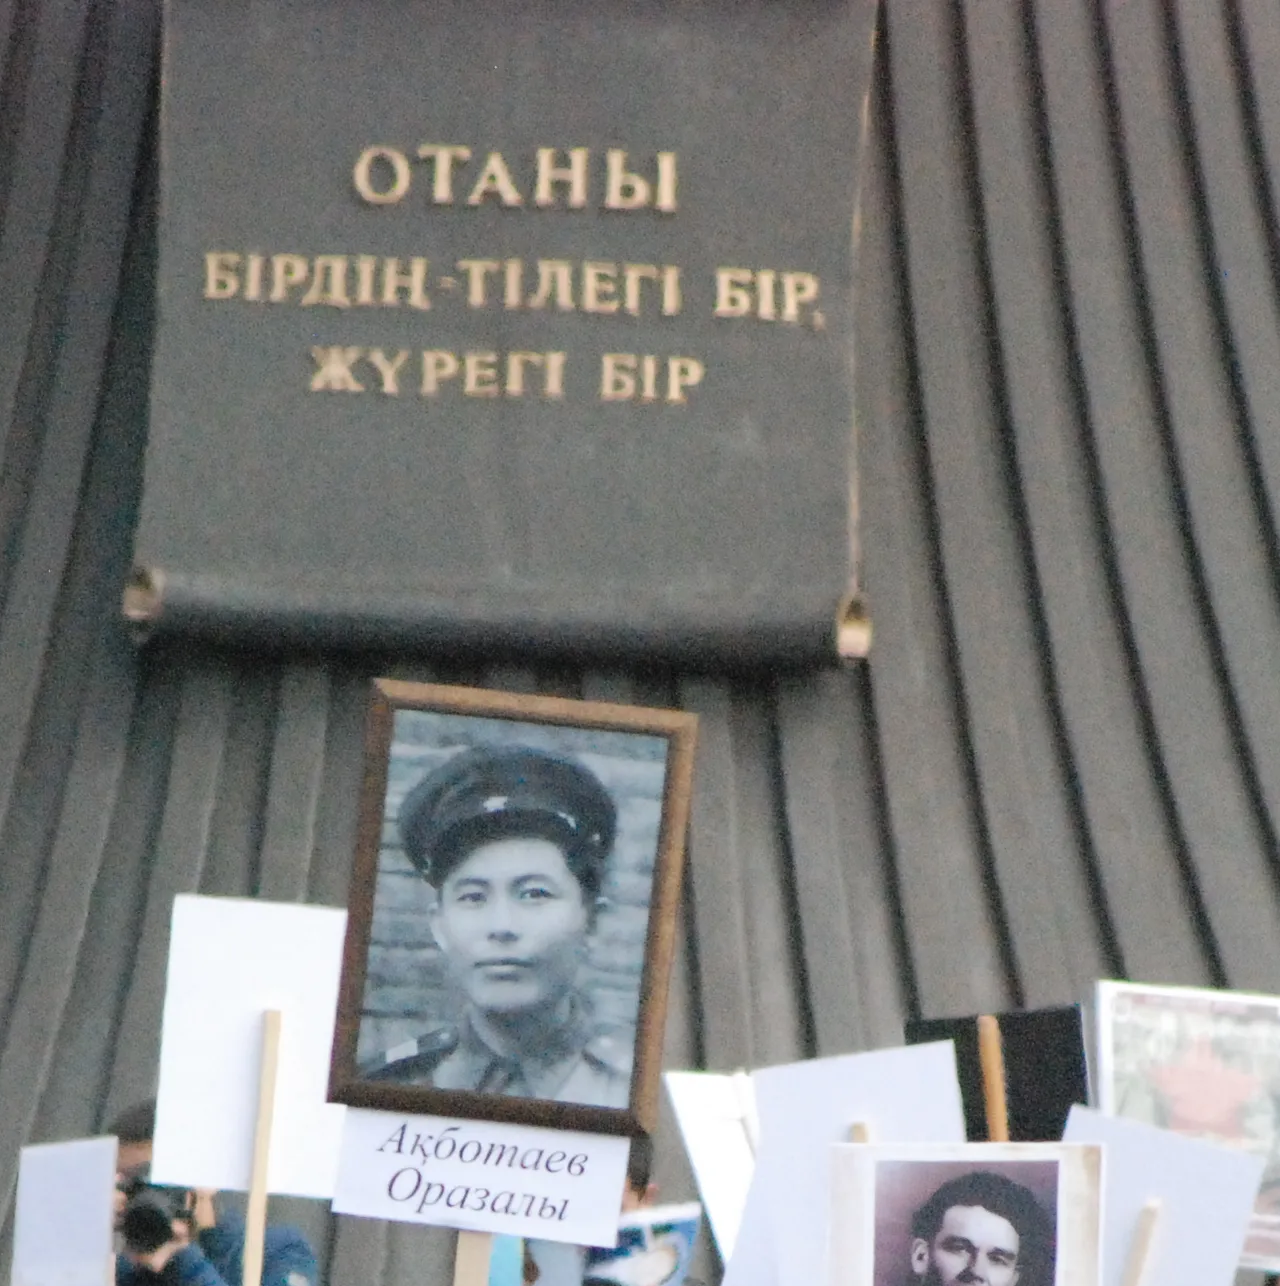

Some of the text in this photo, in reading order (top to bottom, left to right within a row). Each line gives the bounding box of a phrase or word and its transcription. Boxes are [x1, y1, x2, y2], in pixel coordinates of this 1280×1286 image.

[353, 144, 678, 212] ОТАНЫ
[309, 346, 706, 403] ЖҮРЕГІ БІР
[376, 1120, 589, 1177] Ақботаев
[387, 1167, 571, 1222] Оразалы
